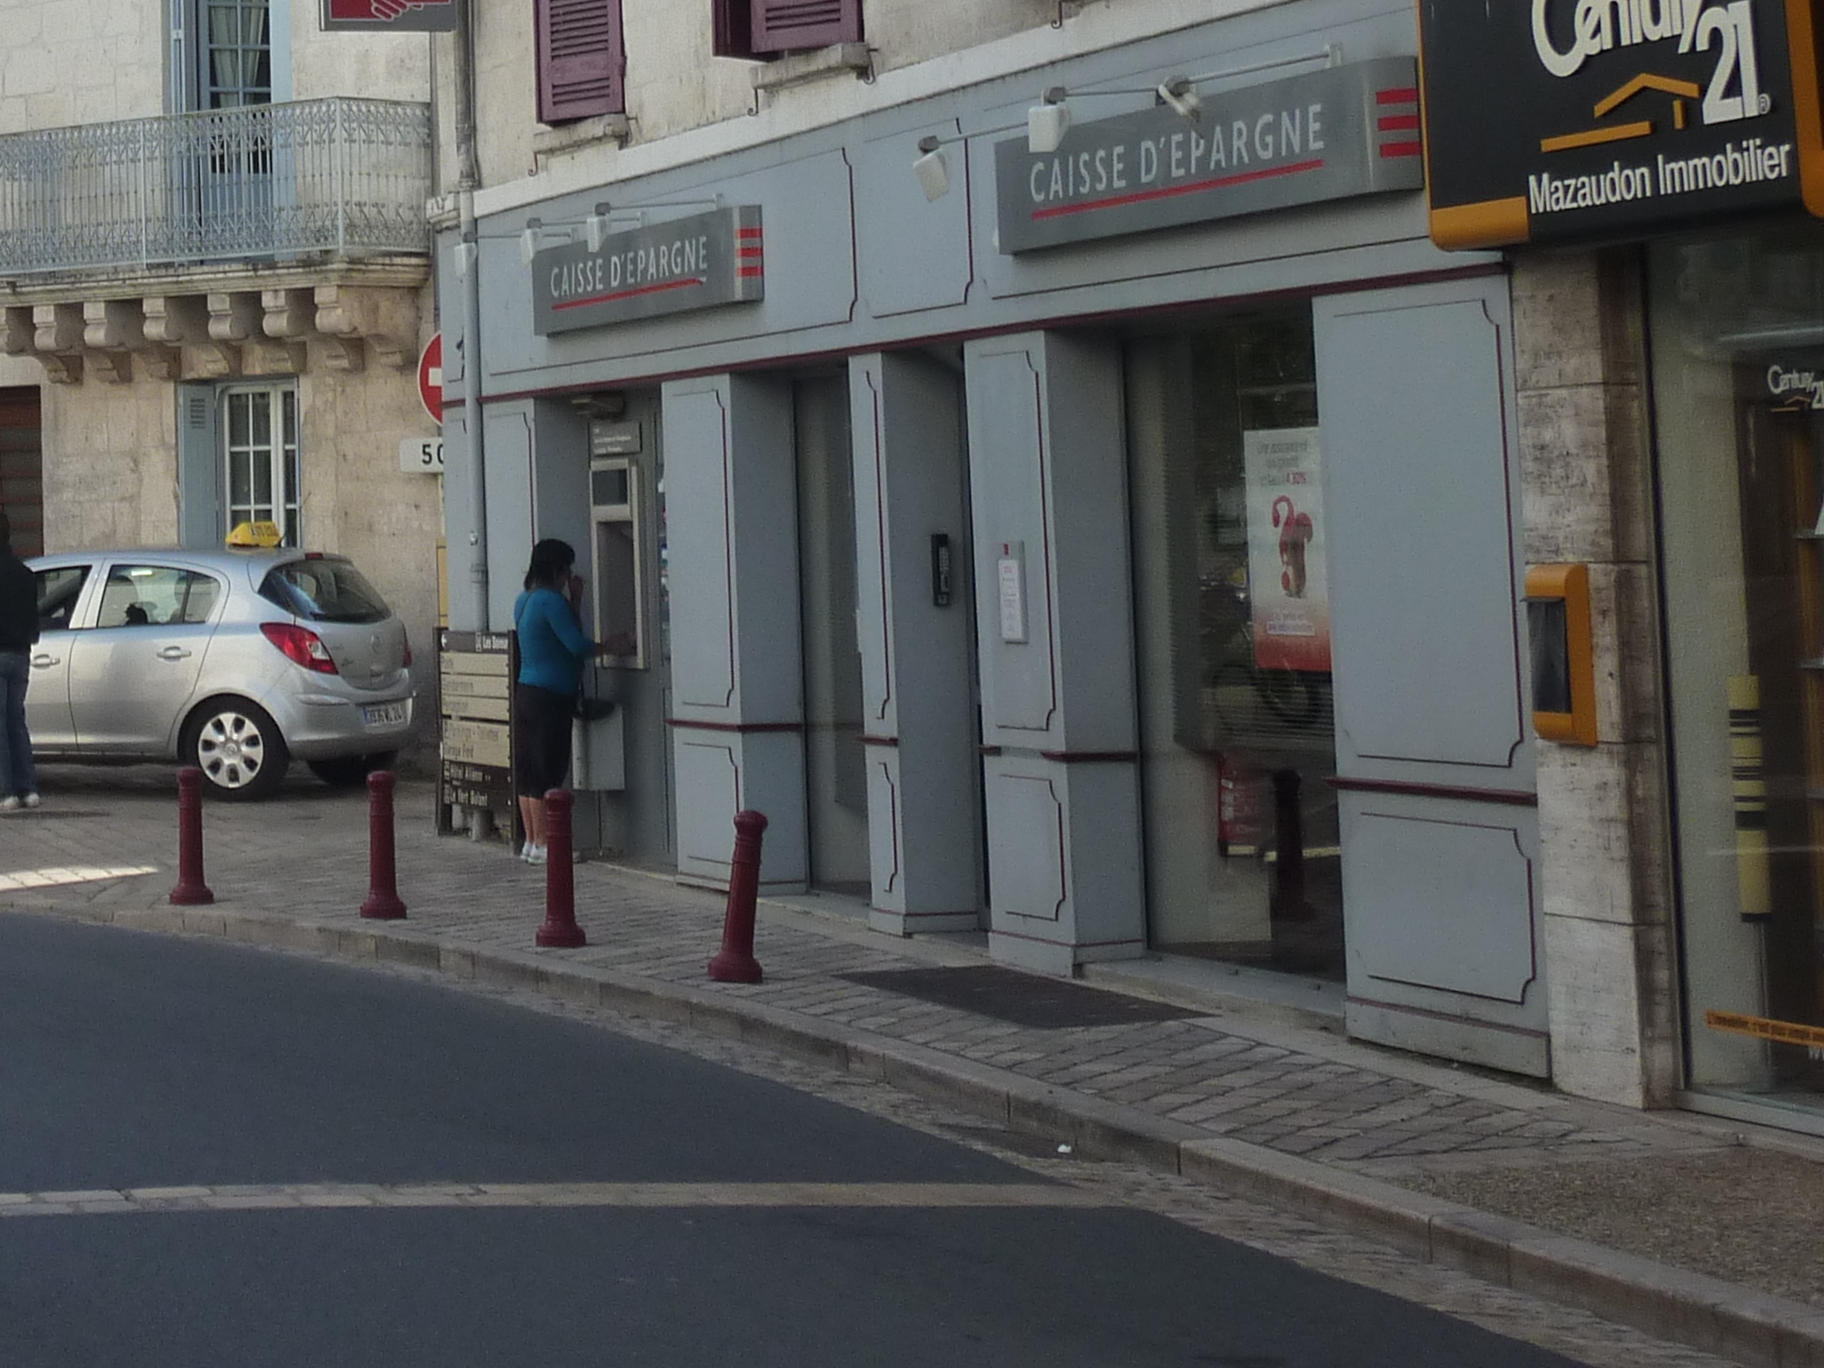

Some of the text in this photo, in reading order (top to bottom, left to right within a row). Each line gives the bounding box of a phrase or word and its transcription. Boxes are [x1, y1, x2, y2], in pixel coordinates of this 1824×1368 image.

[1696, 0, 1760, 125] 21
[1030, 103, 1325, 203] CAISSE D'EPARGNE
[1528, 138, 1791, 214] Mazaudon Immobilier
[550, 236, 708, 299] CAISSE D'EPARGNE
[1767, 365, 1815, 394] Century
